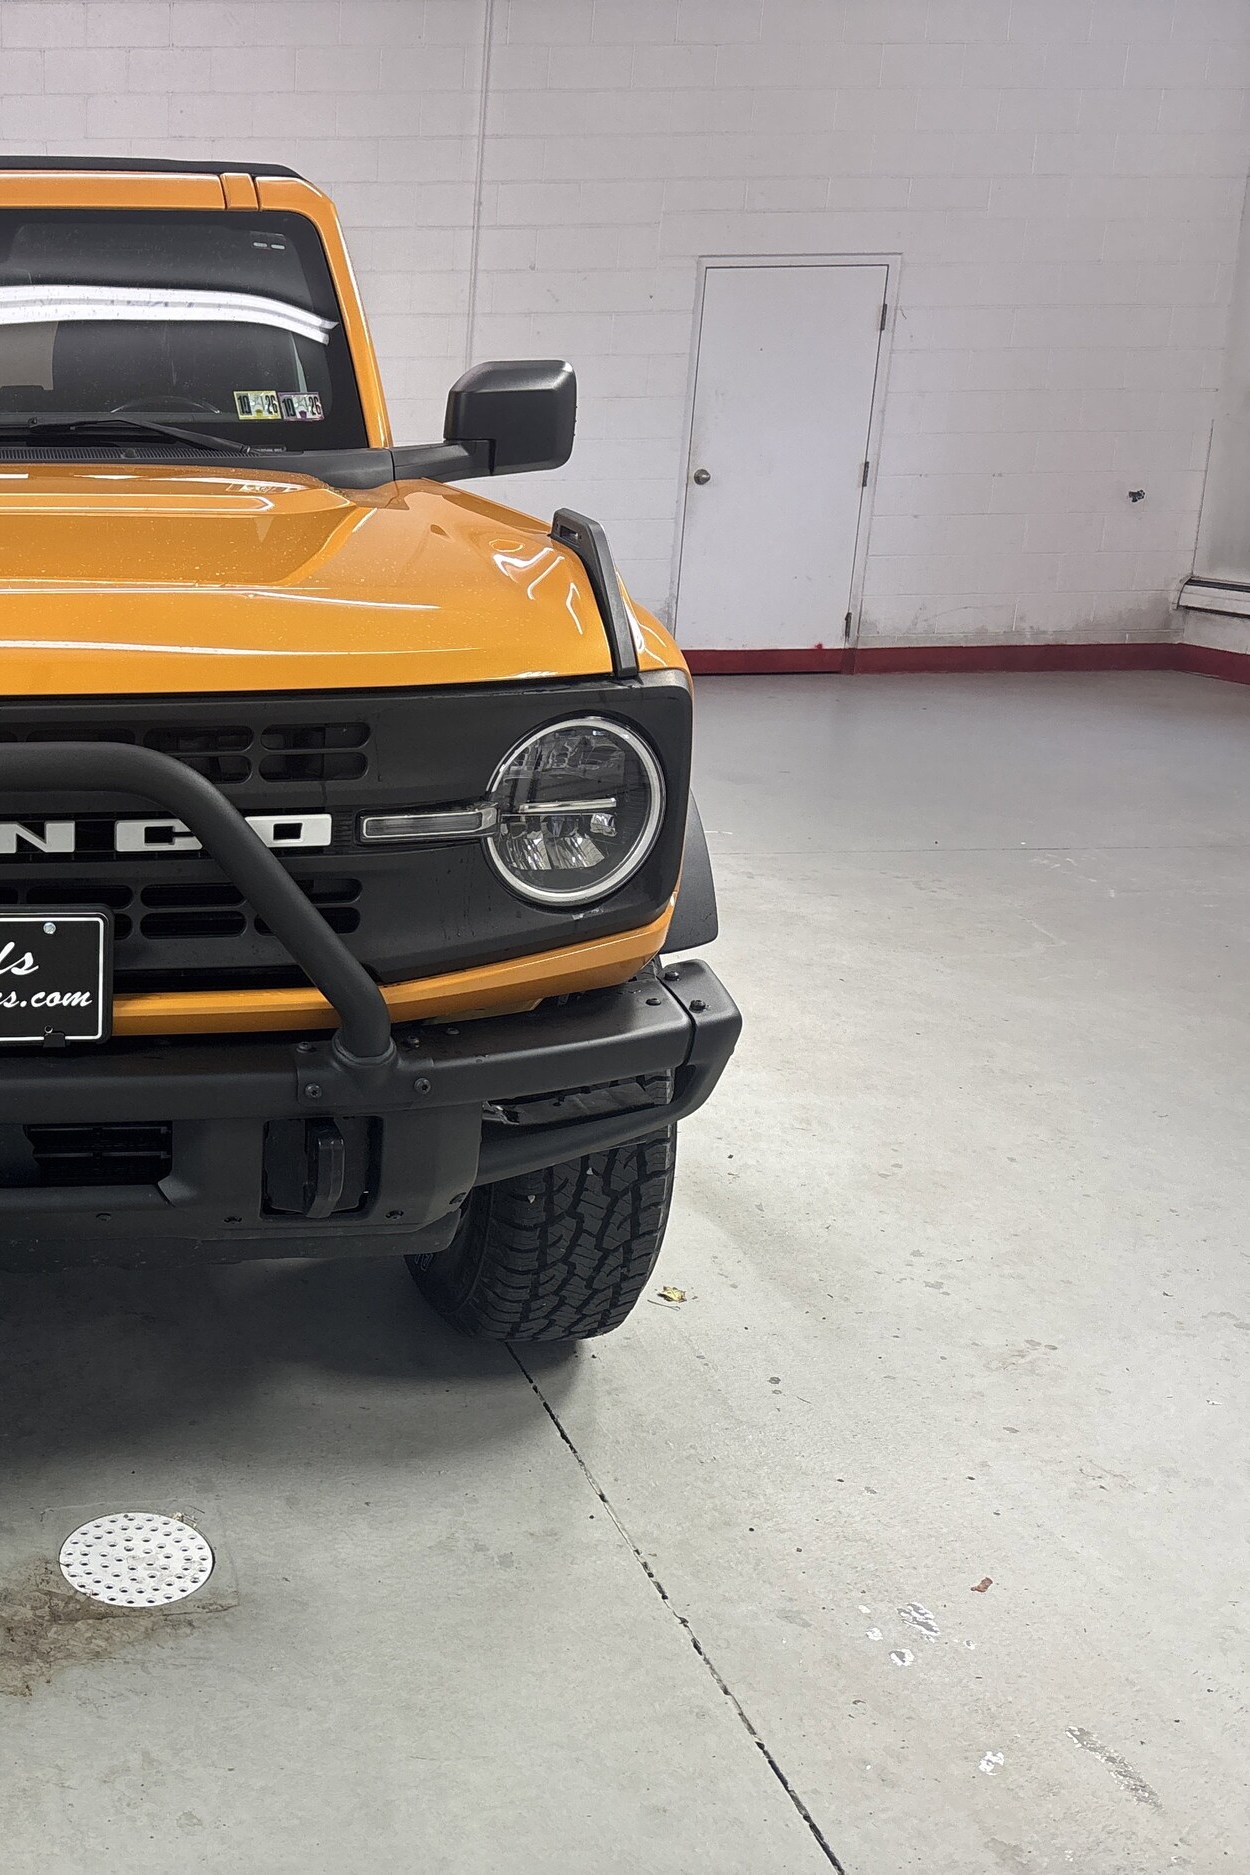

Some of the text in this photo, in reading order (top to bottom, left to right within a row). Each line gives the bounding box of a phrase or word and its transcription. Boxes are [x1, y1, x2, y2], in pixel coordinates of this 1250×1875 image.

[238, 394, 278, 415] 10 26
[282, 396, 322, 417] 10 26
